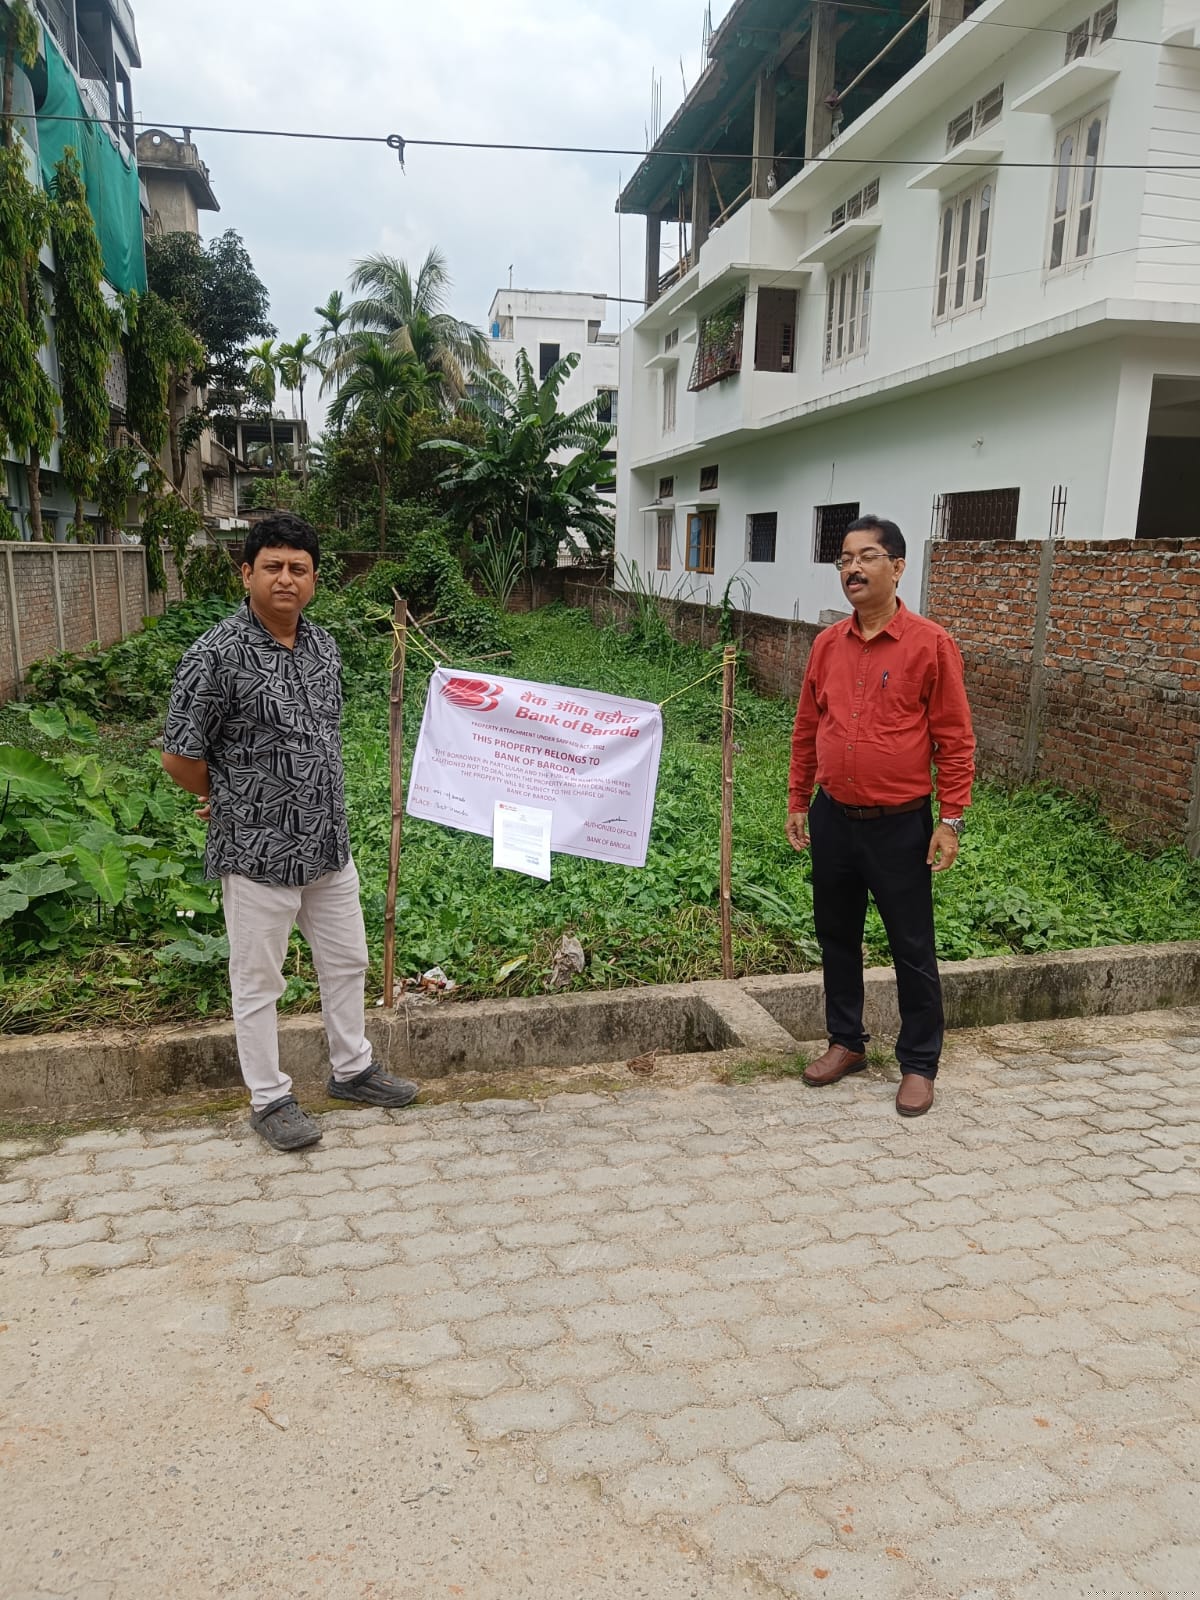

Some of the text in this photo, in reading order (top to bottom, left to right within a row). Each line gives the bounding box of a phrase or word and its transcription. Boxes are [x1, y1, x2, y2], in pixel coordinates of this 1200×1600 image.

[520, 691, 548, 706] बैंक
[594, 709, 640, 725] बड़ौदा
[472, 722, 498, 731] PROPERTY
[499, 727, 535, 738] ATTACHMENT
[537, 734, 555, 743] UNDER
[515, 706, 640, 738] Bank of Baroda
[435, 748, 445, 756] THE
[447, 751, 481, 762] BORROWER
[490, 761, 524, 773] PARTICULAR
[472, 733, 600, 766] THIS PROPERTY BELONGS TO
[432, 756, 465, 768] CAUTIONED
[490, 768, 504, 776] DEAL
[534, 777, 563, 787] PROPERTY
[591, 783, 618, 794] DEALINGS
[494, 751, 576, 775] BANK OF BARODA
[474, 772, 503, 784] PROPERTY
[504, 779, 517, 787] WILL
[526, 784, 550, 793] SUBJECT
[551, 787, 560, 795] TO
[573, 790, 596, 798] CHARGE
[506, 787, 521, 796] BANK
[532, 793, 556, 802] BARODA
[584, 820, 638, 837] AUTHORIZED OFFICER
[586, 835, 600, 844] BANK
[610, 840, 631, 850] BARODA
